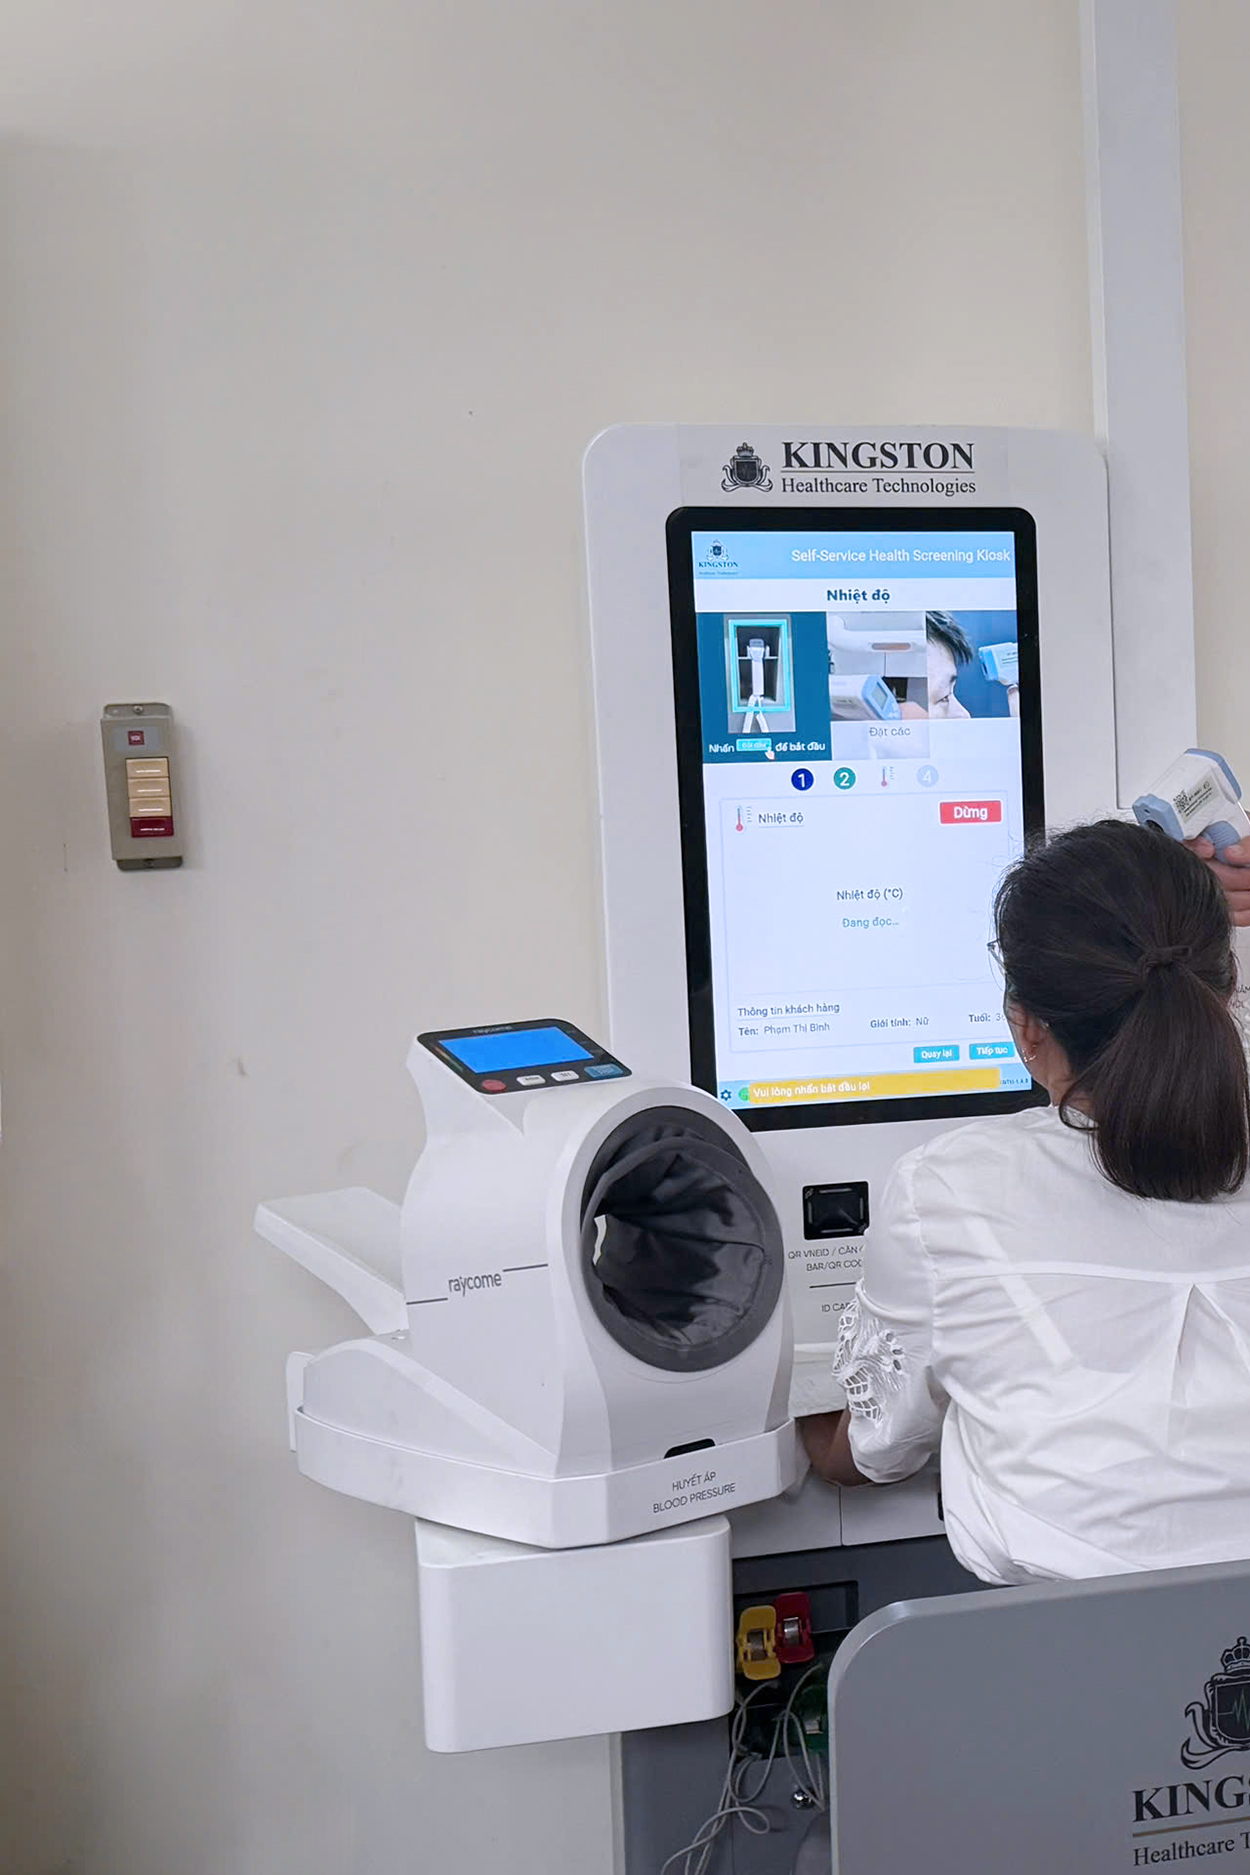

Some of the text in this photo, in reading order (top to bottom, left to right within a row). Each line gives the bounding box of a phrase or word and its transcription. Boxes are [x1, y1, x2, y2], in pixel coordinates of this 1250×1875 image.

[781, 442, 975, 469] KINGSTON
[781, 478, 976, 497] Healthcare Technologies
[791, 549, 1011, 563] Self-Service Health Screening Kiosk
[826, 588, 890, 604] Nhiệt độ
[839, 771, 850, 786] 2
[758, 811, 804, 824] Nhiệt độ
[953, 805, 988, 821] Dừng
[836, 887, 903, 901] Nhiệt độ (°C)
[842, 918, 870, 929] Đang
[788, 1250, 801, 1259] QR
[447, 1271, 502, 1297] raycome
[821, 1304, 831, 1312] ID
[653, 1482, 736, 1513] BLOOD PRESSURE
[1133, 1839, 1235, 1866] Healthcare
